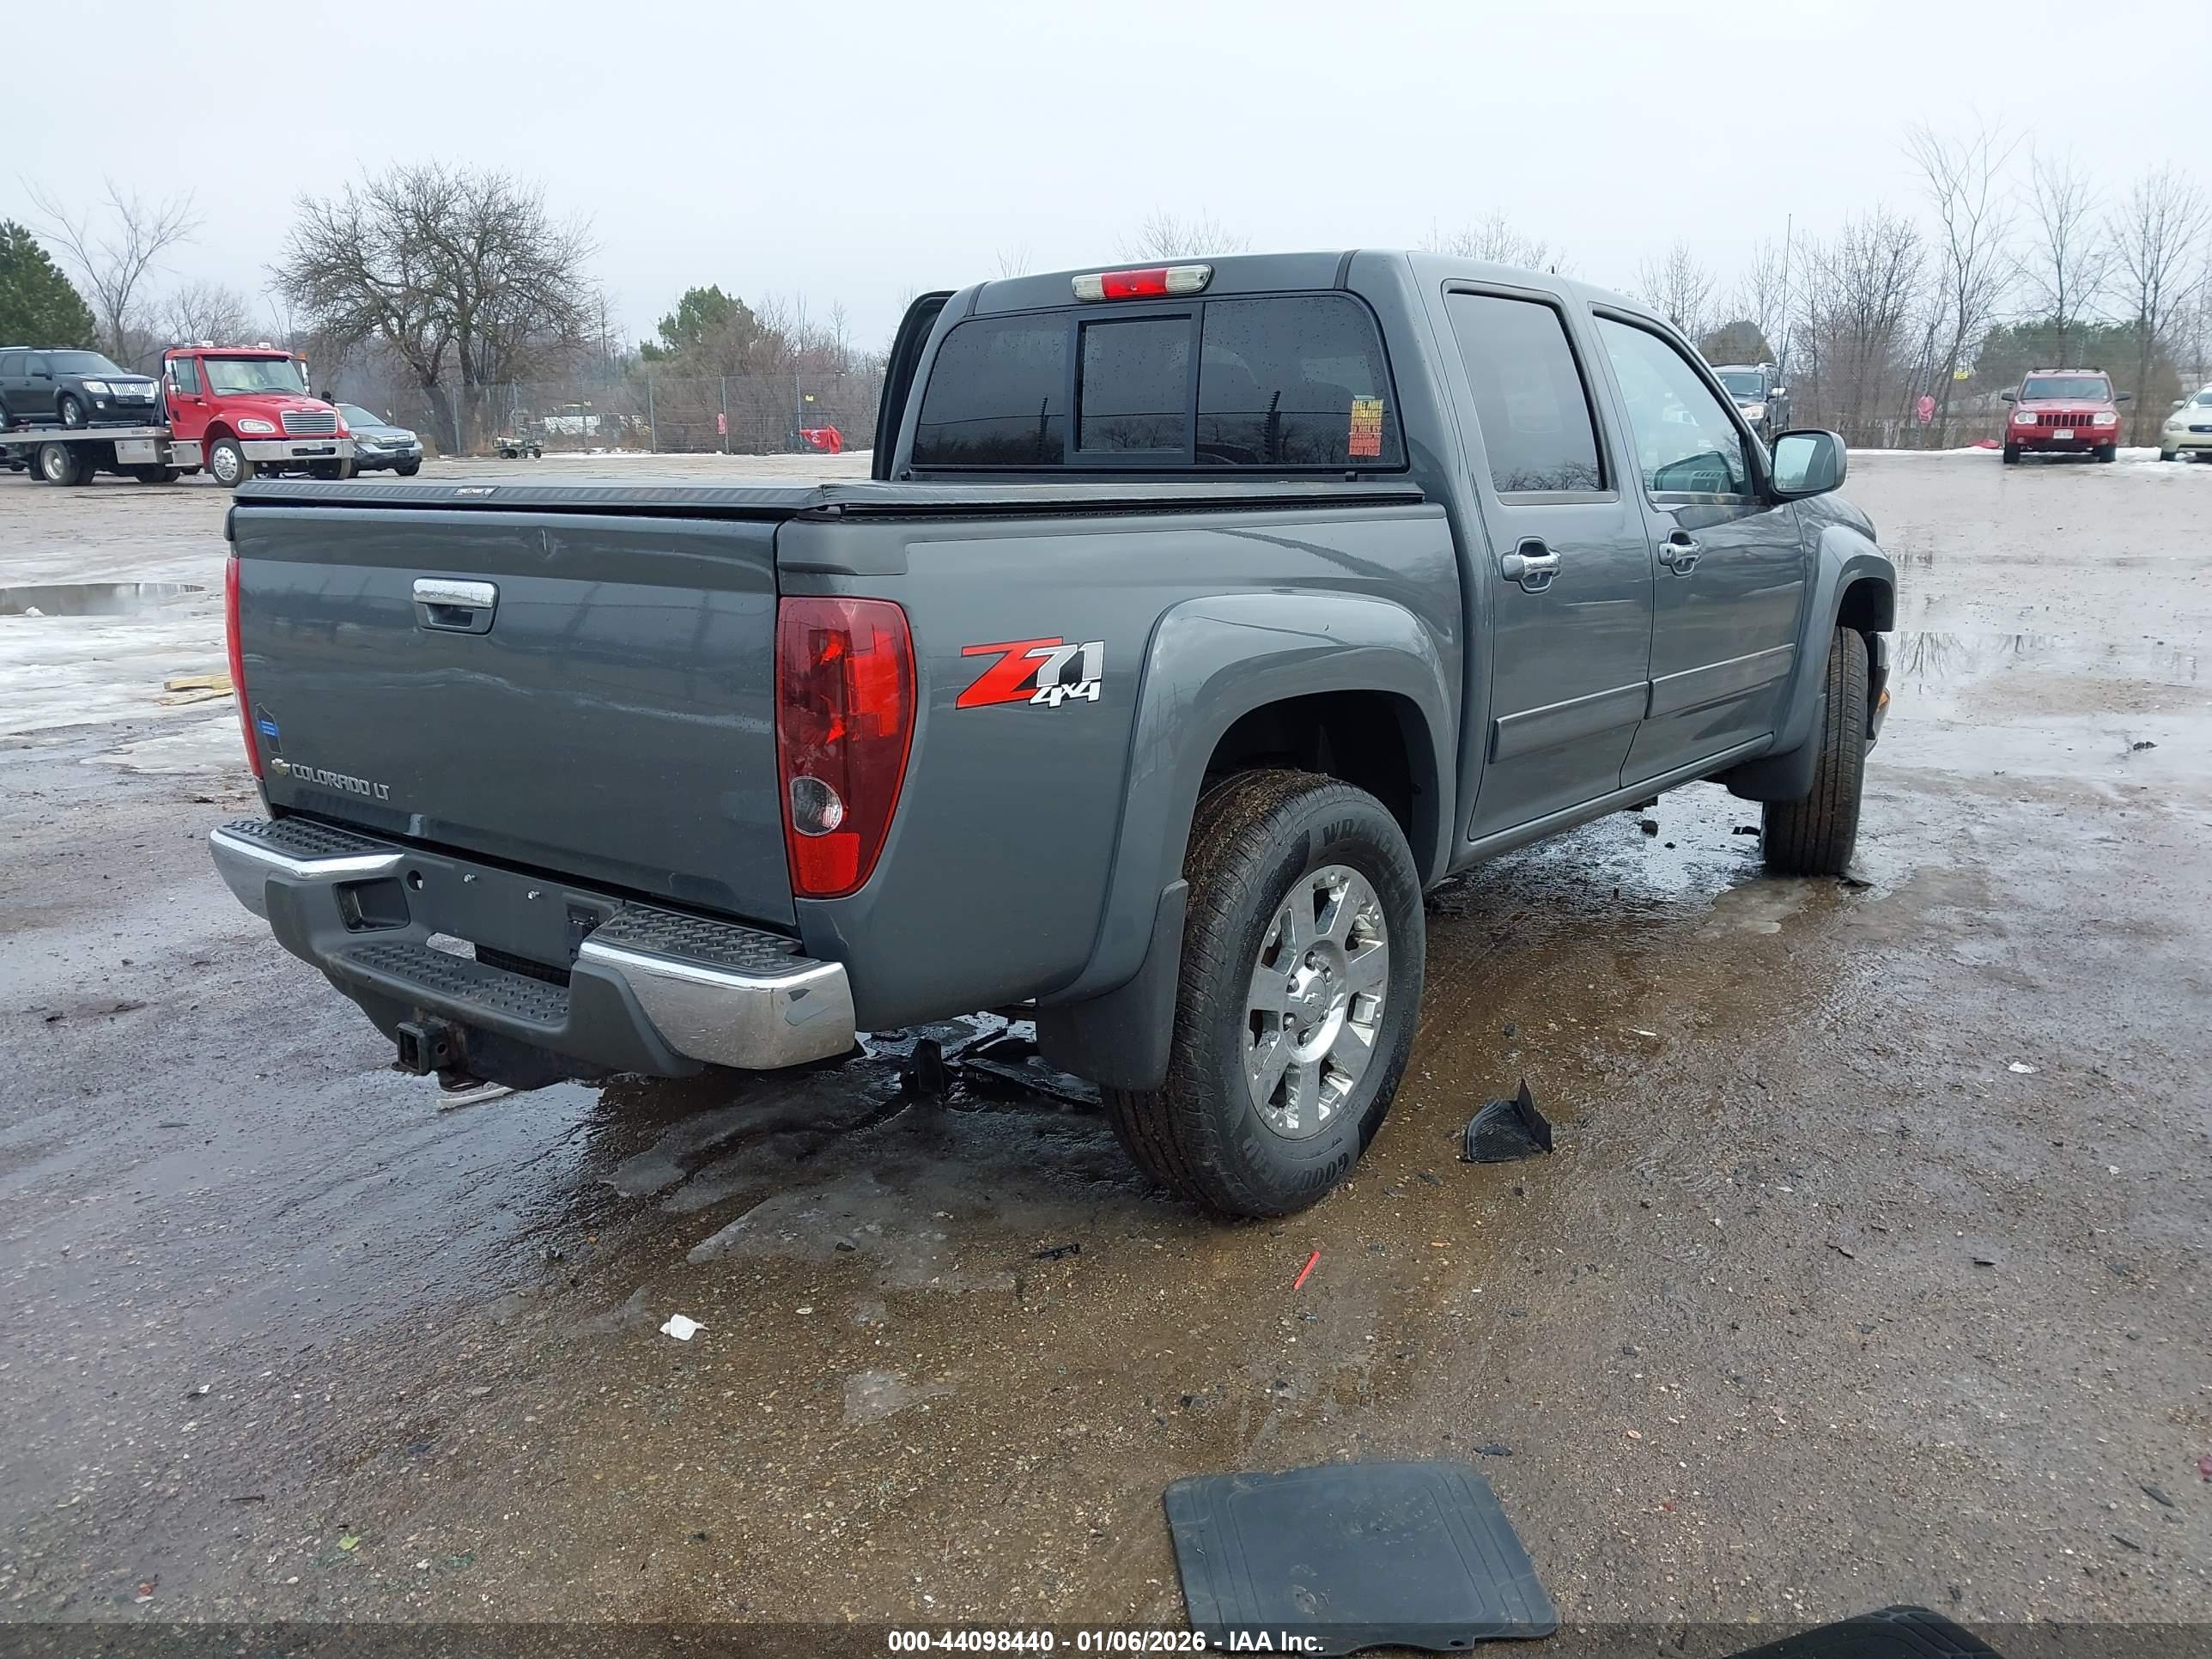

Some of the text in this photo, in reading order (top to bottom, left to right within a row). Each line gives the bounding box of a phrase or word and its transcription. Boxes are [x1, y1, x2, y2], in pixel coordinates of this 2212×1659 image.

[956, 636, 1105, 709] Z71
[292, 763, 390, 800] COLORADO LT
